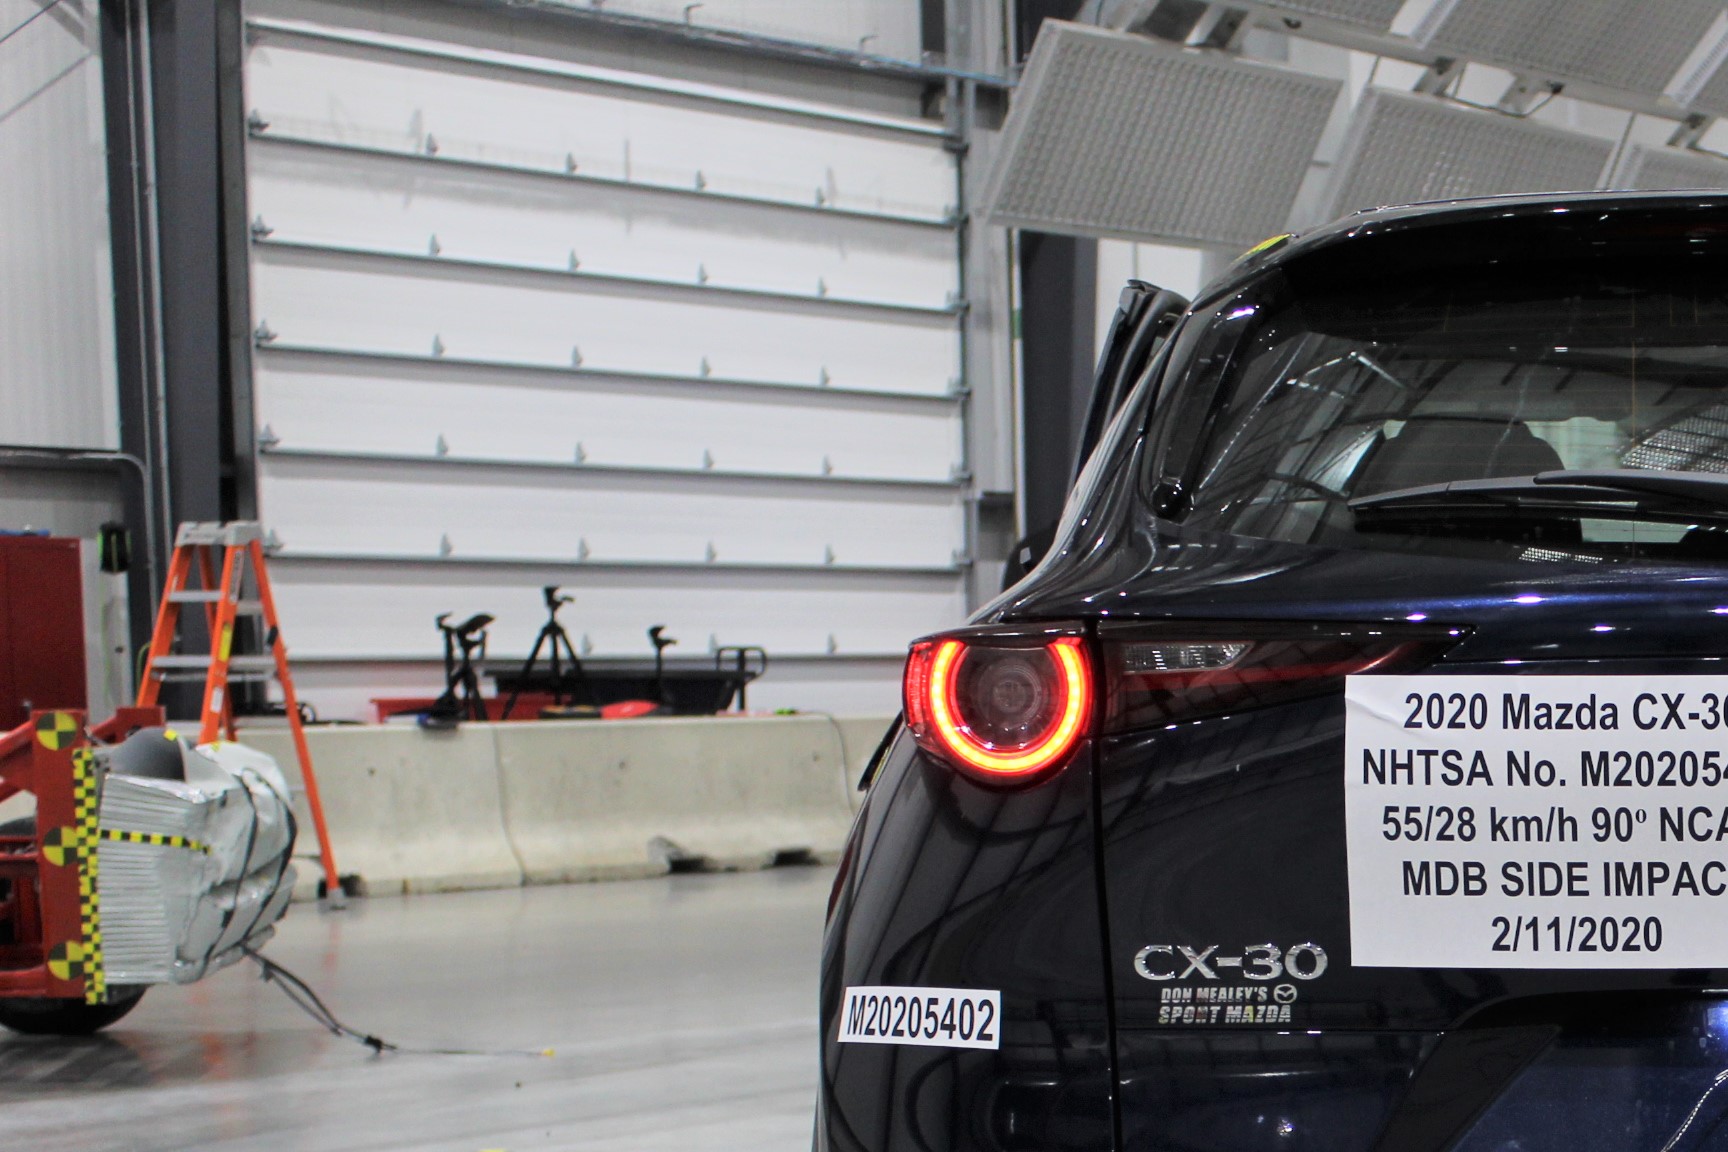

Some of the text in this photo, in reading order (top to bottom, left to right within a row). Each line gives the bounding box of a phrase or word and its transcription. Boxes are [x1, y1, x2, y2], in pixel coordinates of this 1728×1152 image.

[1404, 693, 1488, 730] 2020
[1503, 693, 1619, 731] Mazda
[1363, 748, 1494, 787] NHTSA
[1506, 750, 1567, 788] No.
[1382, 805, 1477, 842] 55/28
[1490, 806, 1578, 843] km/h
[1402, 860, 1488, 897] MDB
[1500, 860, 1590, 897] SIDE
[1491, 914, 1663, 953] 2/11/2020
[1133, 941, 1328, 981] CX-30
[1158, 1004, 1292, 1024] SPORT MAZDA
[1160, 987, 1193, 1004] DON
[846, 994, 994, 1042] M20205402
